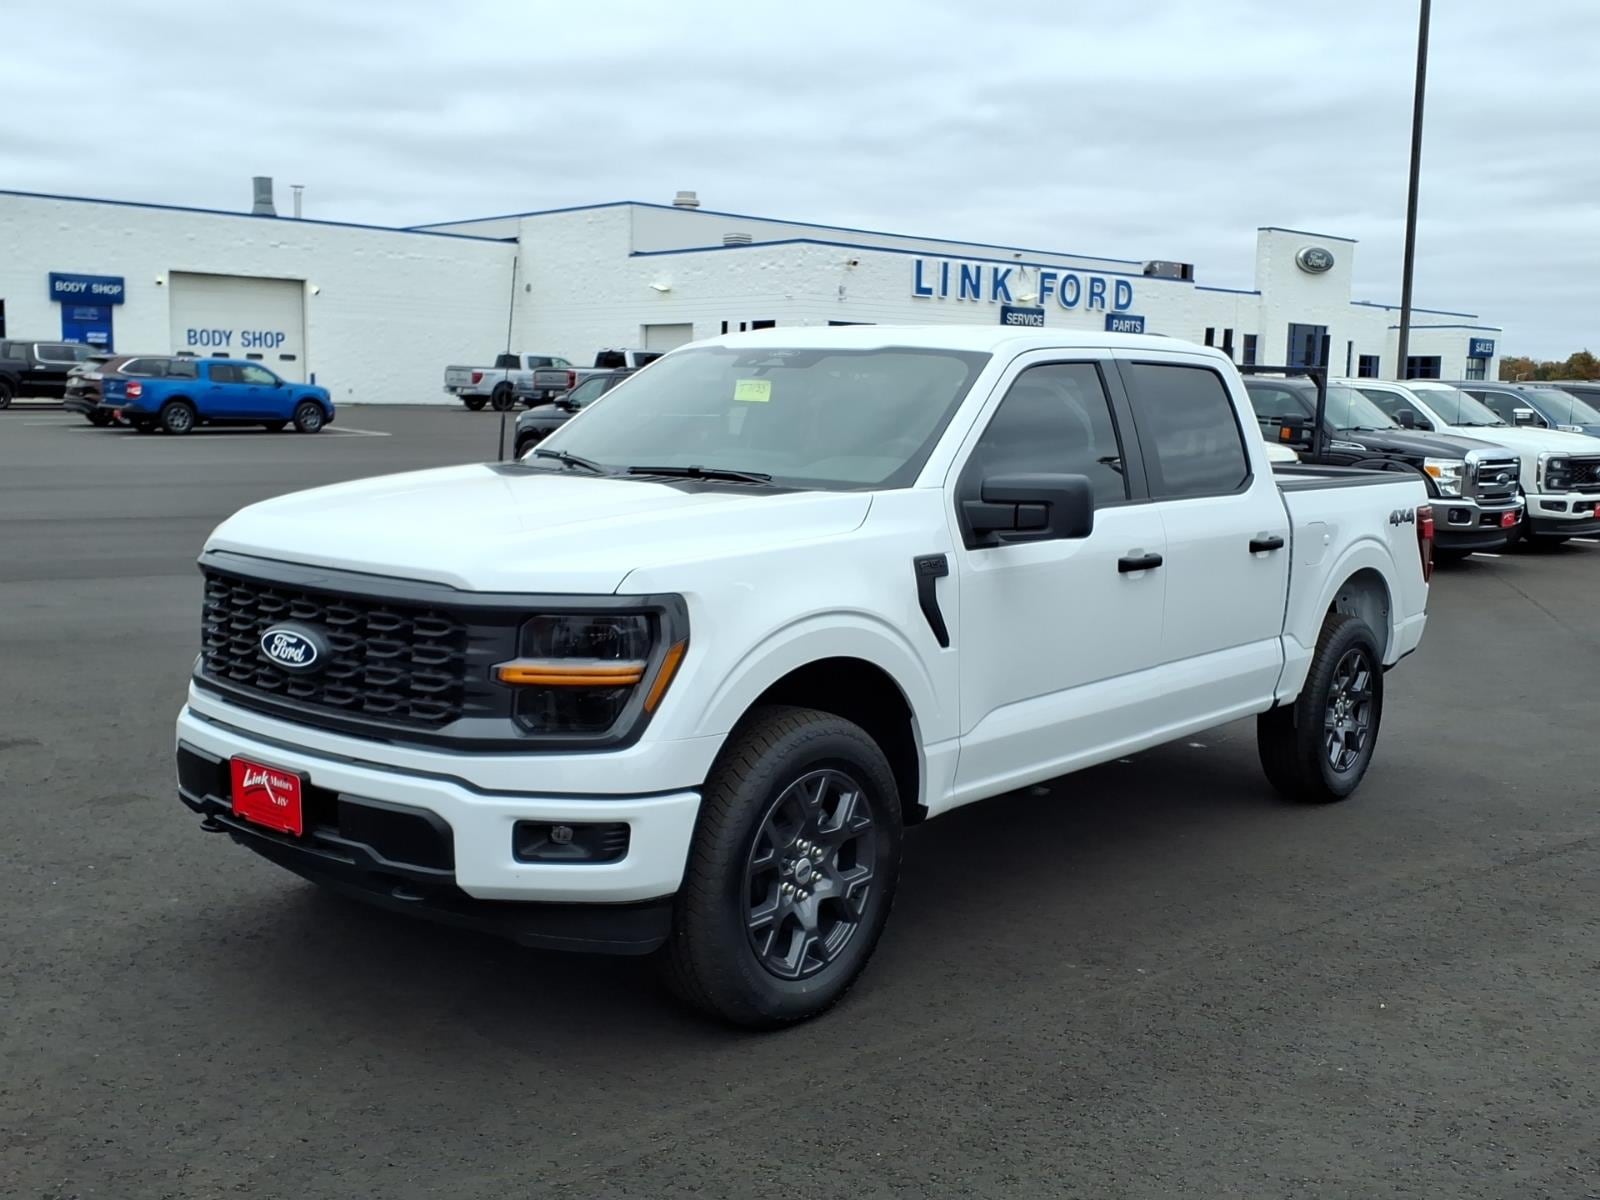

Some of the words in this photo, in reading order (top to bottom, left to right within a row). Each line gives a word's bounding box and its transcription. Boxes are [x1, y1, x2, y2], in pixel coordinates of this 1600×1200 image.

[55, 280, 88, 293] BODY
[91, 283, 122, 296] SHOP
[914, 258, 1013, 304] LINK
[1037, 269, 1134, 312] FORD
[1006, 312, 1044, 327] SERVICE
[1112, 319, 1142, 334] PARTS
[187, 328, 233, 347] BODY
[241, 330, 286, 348] SHOP
[1475, 342, 1493, 353] SALES
[271, 634, 305, 662] Ford
[243, 769, 273, 798] Link
[271, 776, 293, 791] Motors
